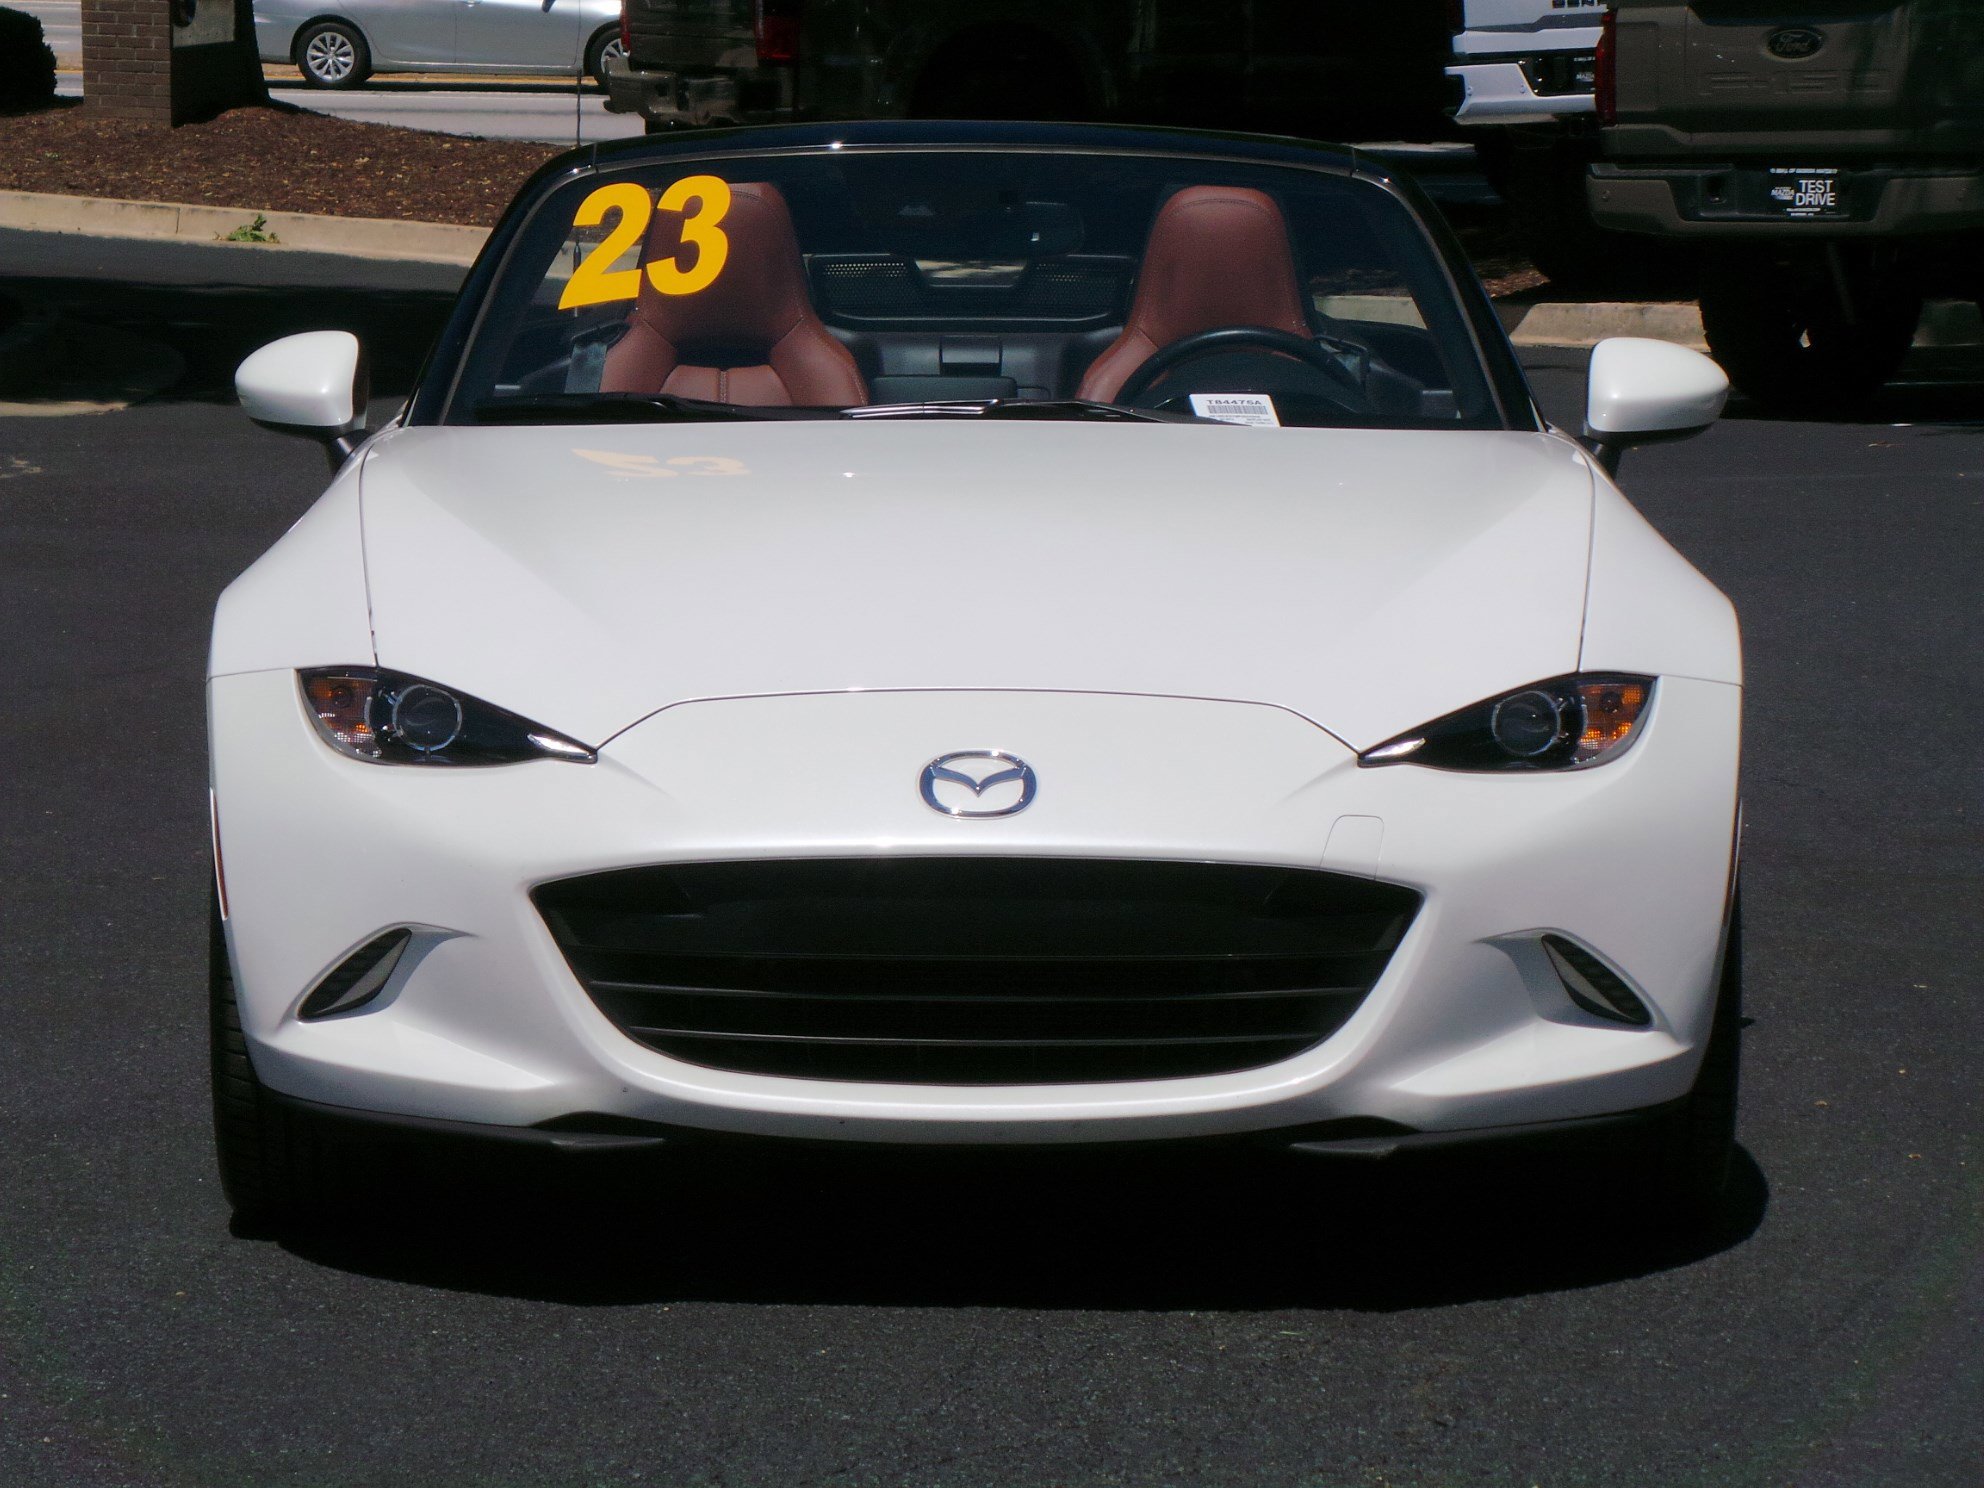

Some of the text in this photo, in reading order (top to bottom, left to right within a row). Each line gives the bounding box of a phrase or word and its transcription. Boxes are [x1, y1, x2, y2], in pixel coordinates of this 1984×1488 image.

[1775, 32, 1812, 54] Ford
[1798, 180, 1834, 193] TEST
[1795, 192, 1836, 206] DRIVE
[557, 174, 732, 311] 23
